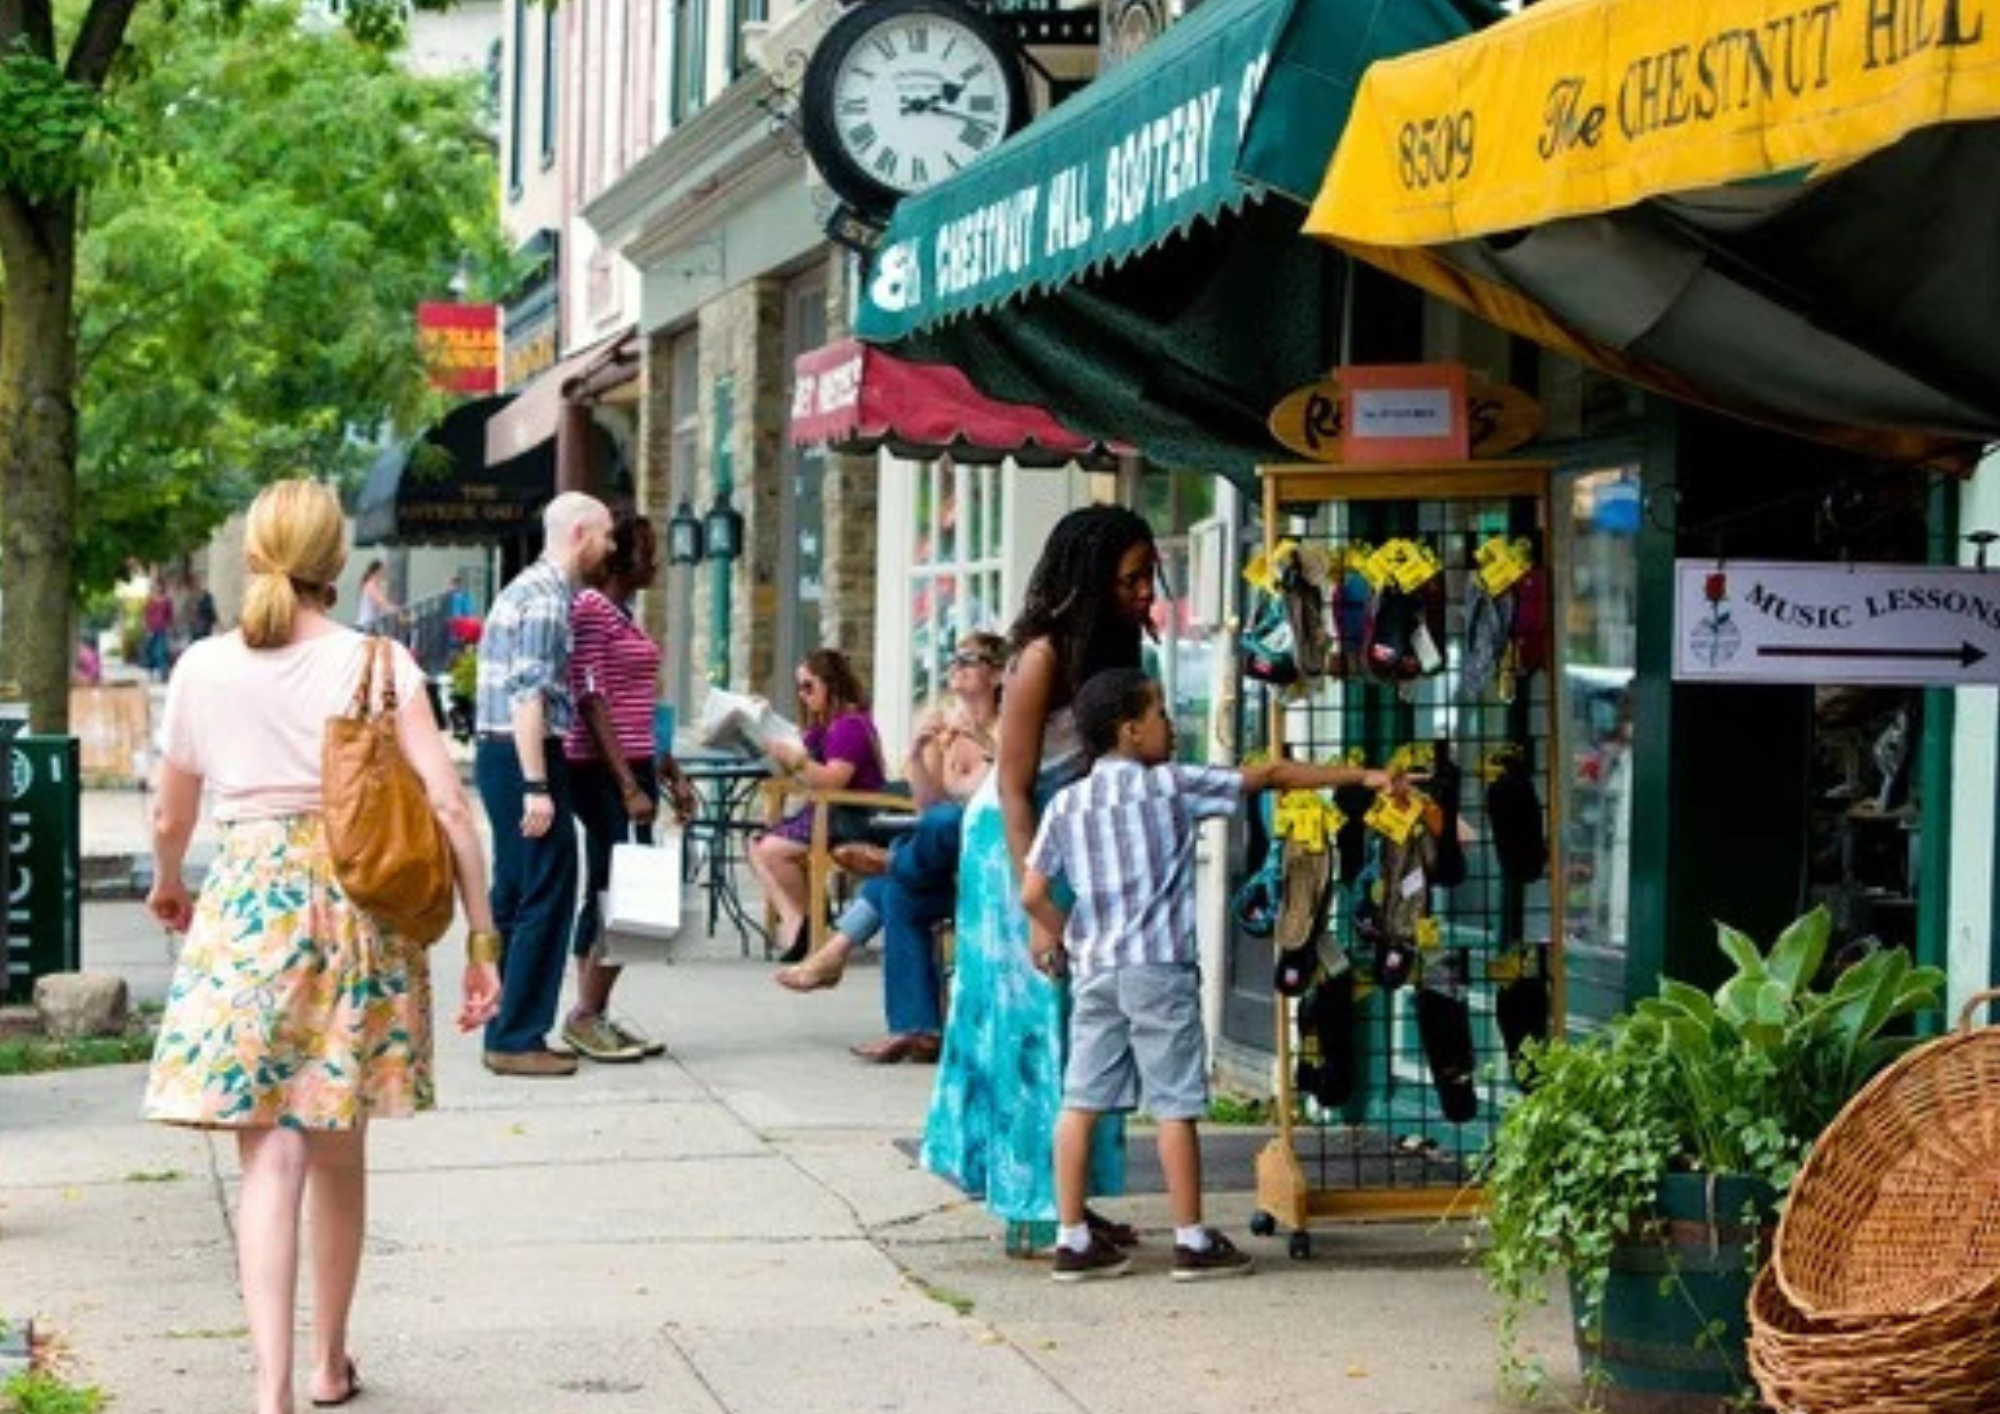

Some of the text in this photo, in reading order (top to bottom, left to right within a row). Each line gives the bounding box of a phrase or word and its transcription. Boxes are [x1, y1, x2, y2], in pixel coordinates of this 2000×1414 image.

[1398, 108, 1475, 191] 8509
[1538, 77, 1607, 162] The
[1617, 0, 1840, 142] CHESTNUT
[936, 186, 1039, 297] CHESTNUT
[1045, 161, 1093, 258] HILL
[1103, 86, 1222, 234] BOOTERY
[1745, 579, 1853, 629] MUSIC
